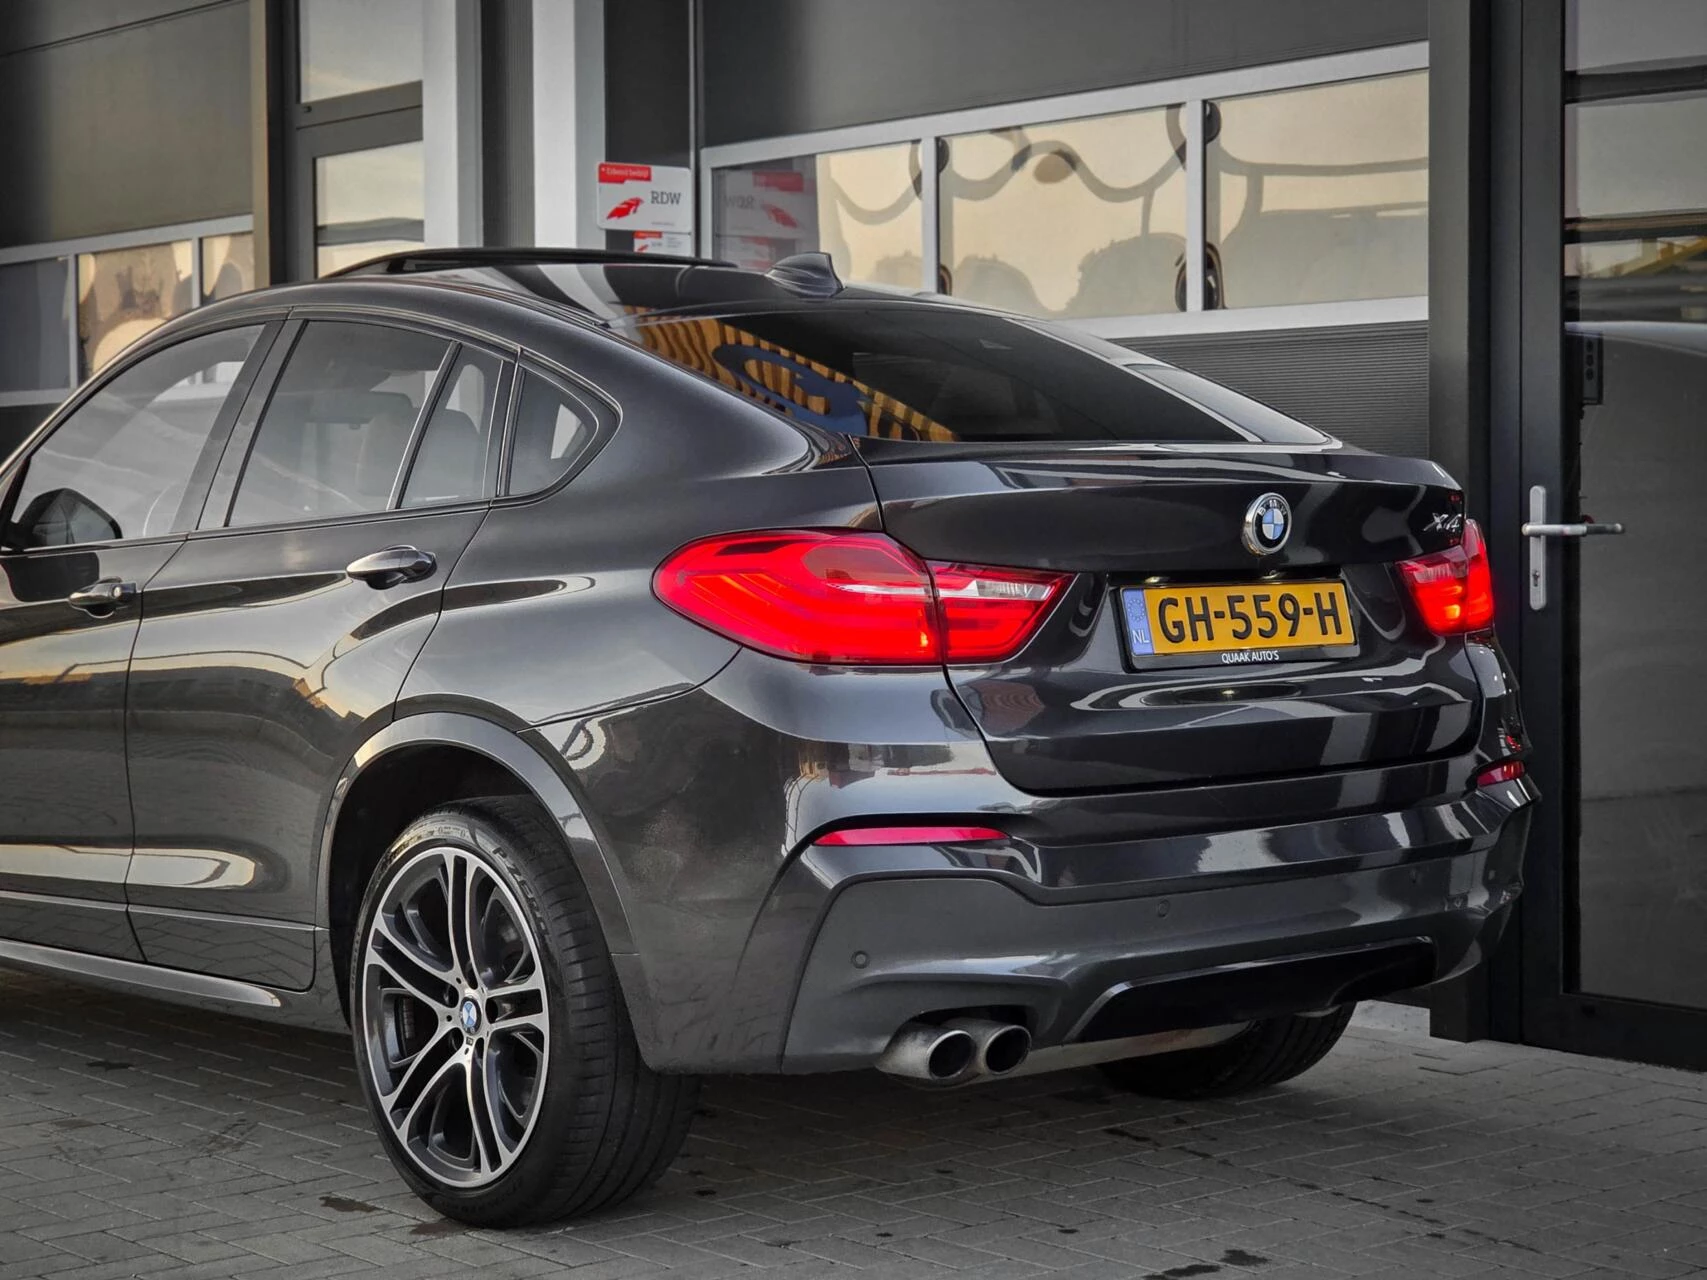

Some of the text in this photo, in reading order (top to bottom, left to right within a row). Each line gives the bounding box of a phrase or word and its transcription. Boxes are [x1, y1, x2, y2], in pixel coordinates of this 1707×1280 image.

[651, 191, 681, 204] RDW
[1257, 499, 1287, 516] BMW
[1423, 512, 1462, 532] X4
[1158, 592, 1342, 643] GH-559-H
[1132, 630, 1149, 644] NL
[1221, 650, 1280, 664] QUAAK AUTO'S
